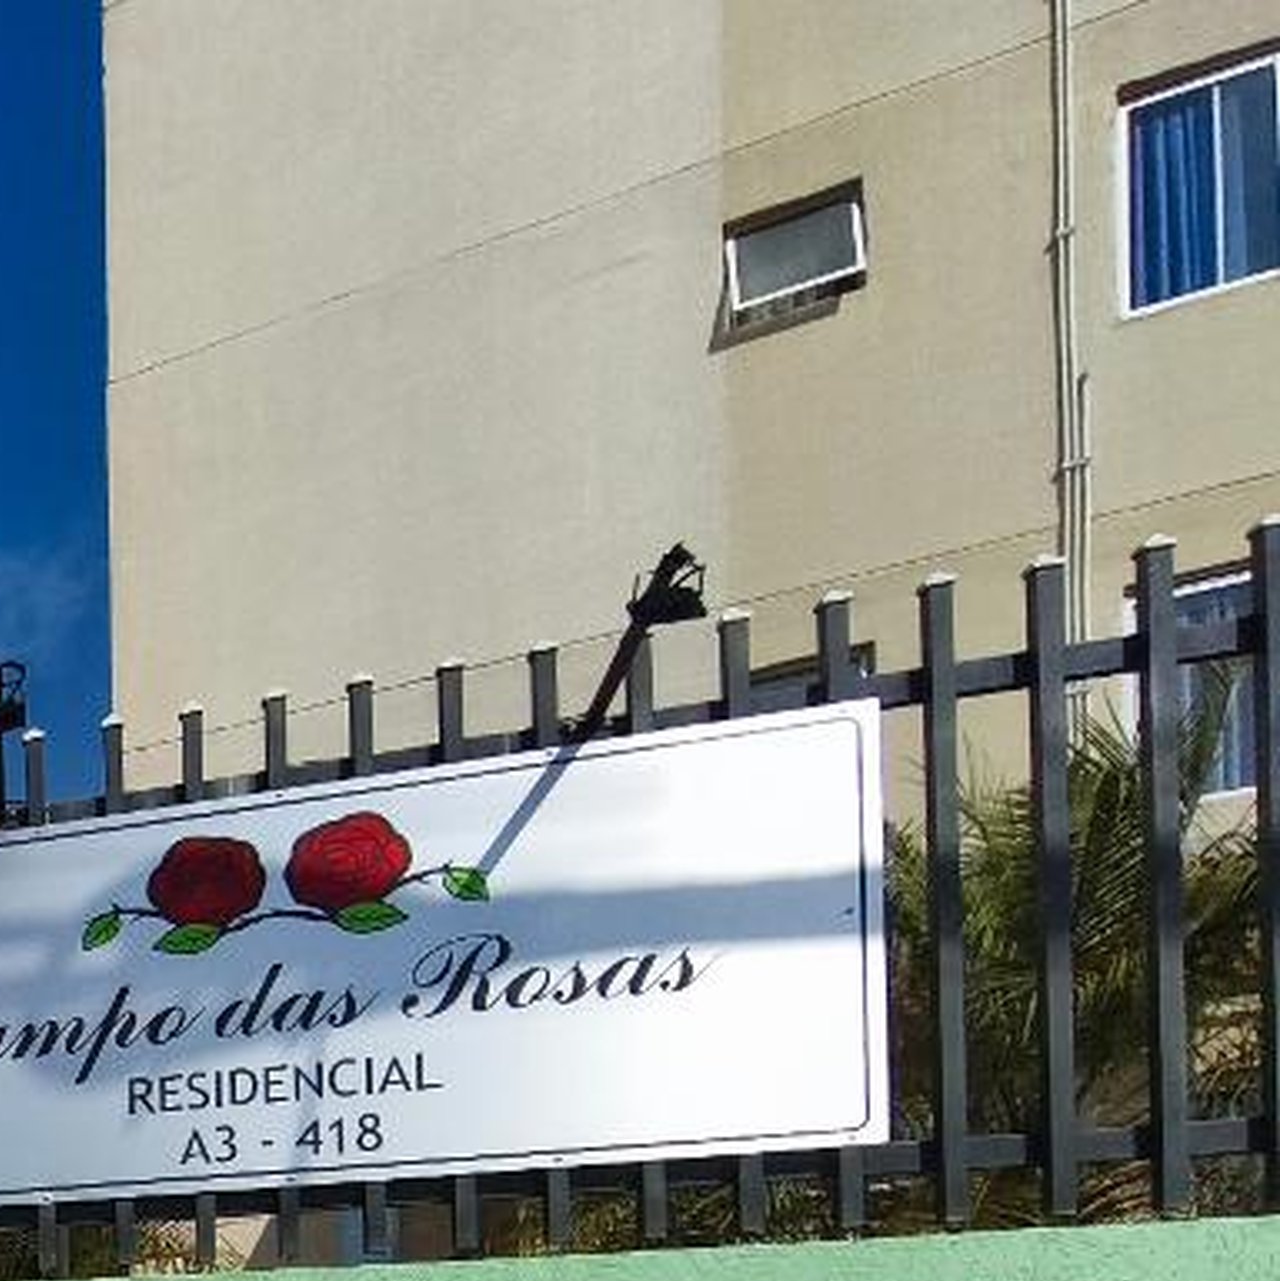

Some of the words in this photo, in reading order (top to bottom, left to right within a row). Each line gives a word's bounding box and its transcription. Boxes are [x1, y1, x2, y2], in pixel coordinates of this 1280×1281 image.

[214, 962, 377, 1038] das
[402, 933, 714, 1018] Rosas
[127, 1052, 443, 1115] RESIDENCIAL
[179, 1125, 238, 1165] A3
[294, 1113, 383, 1156] 418
